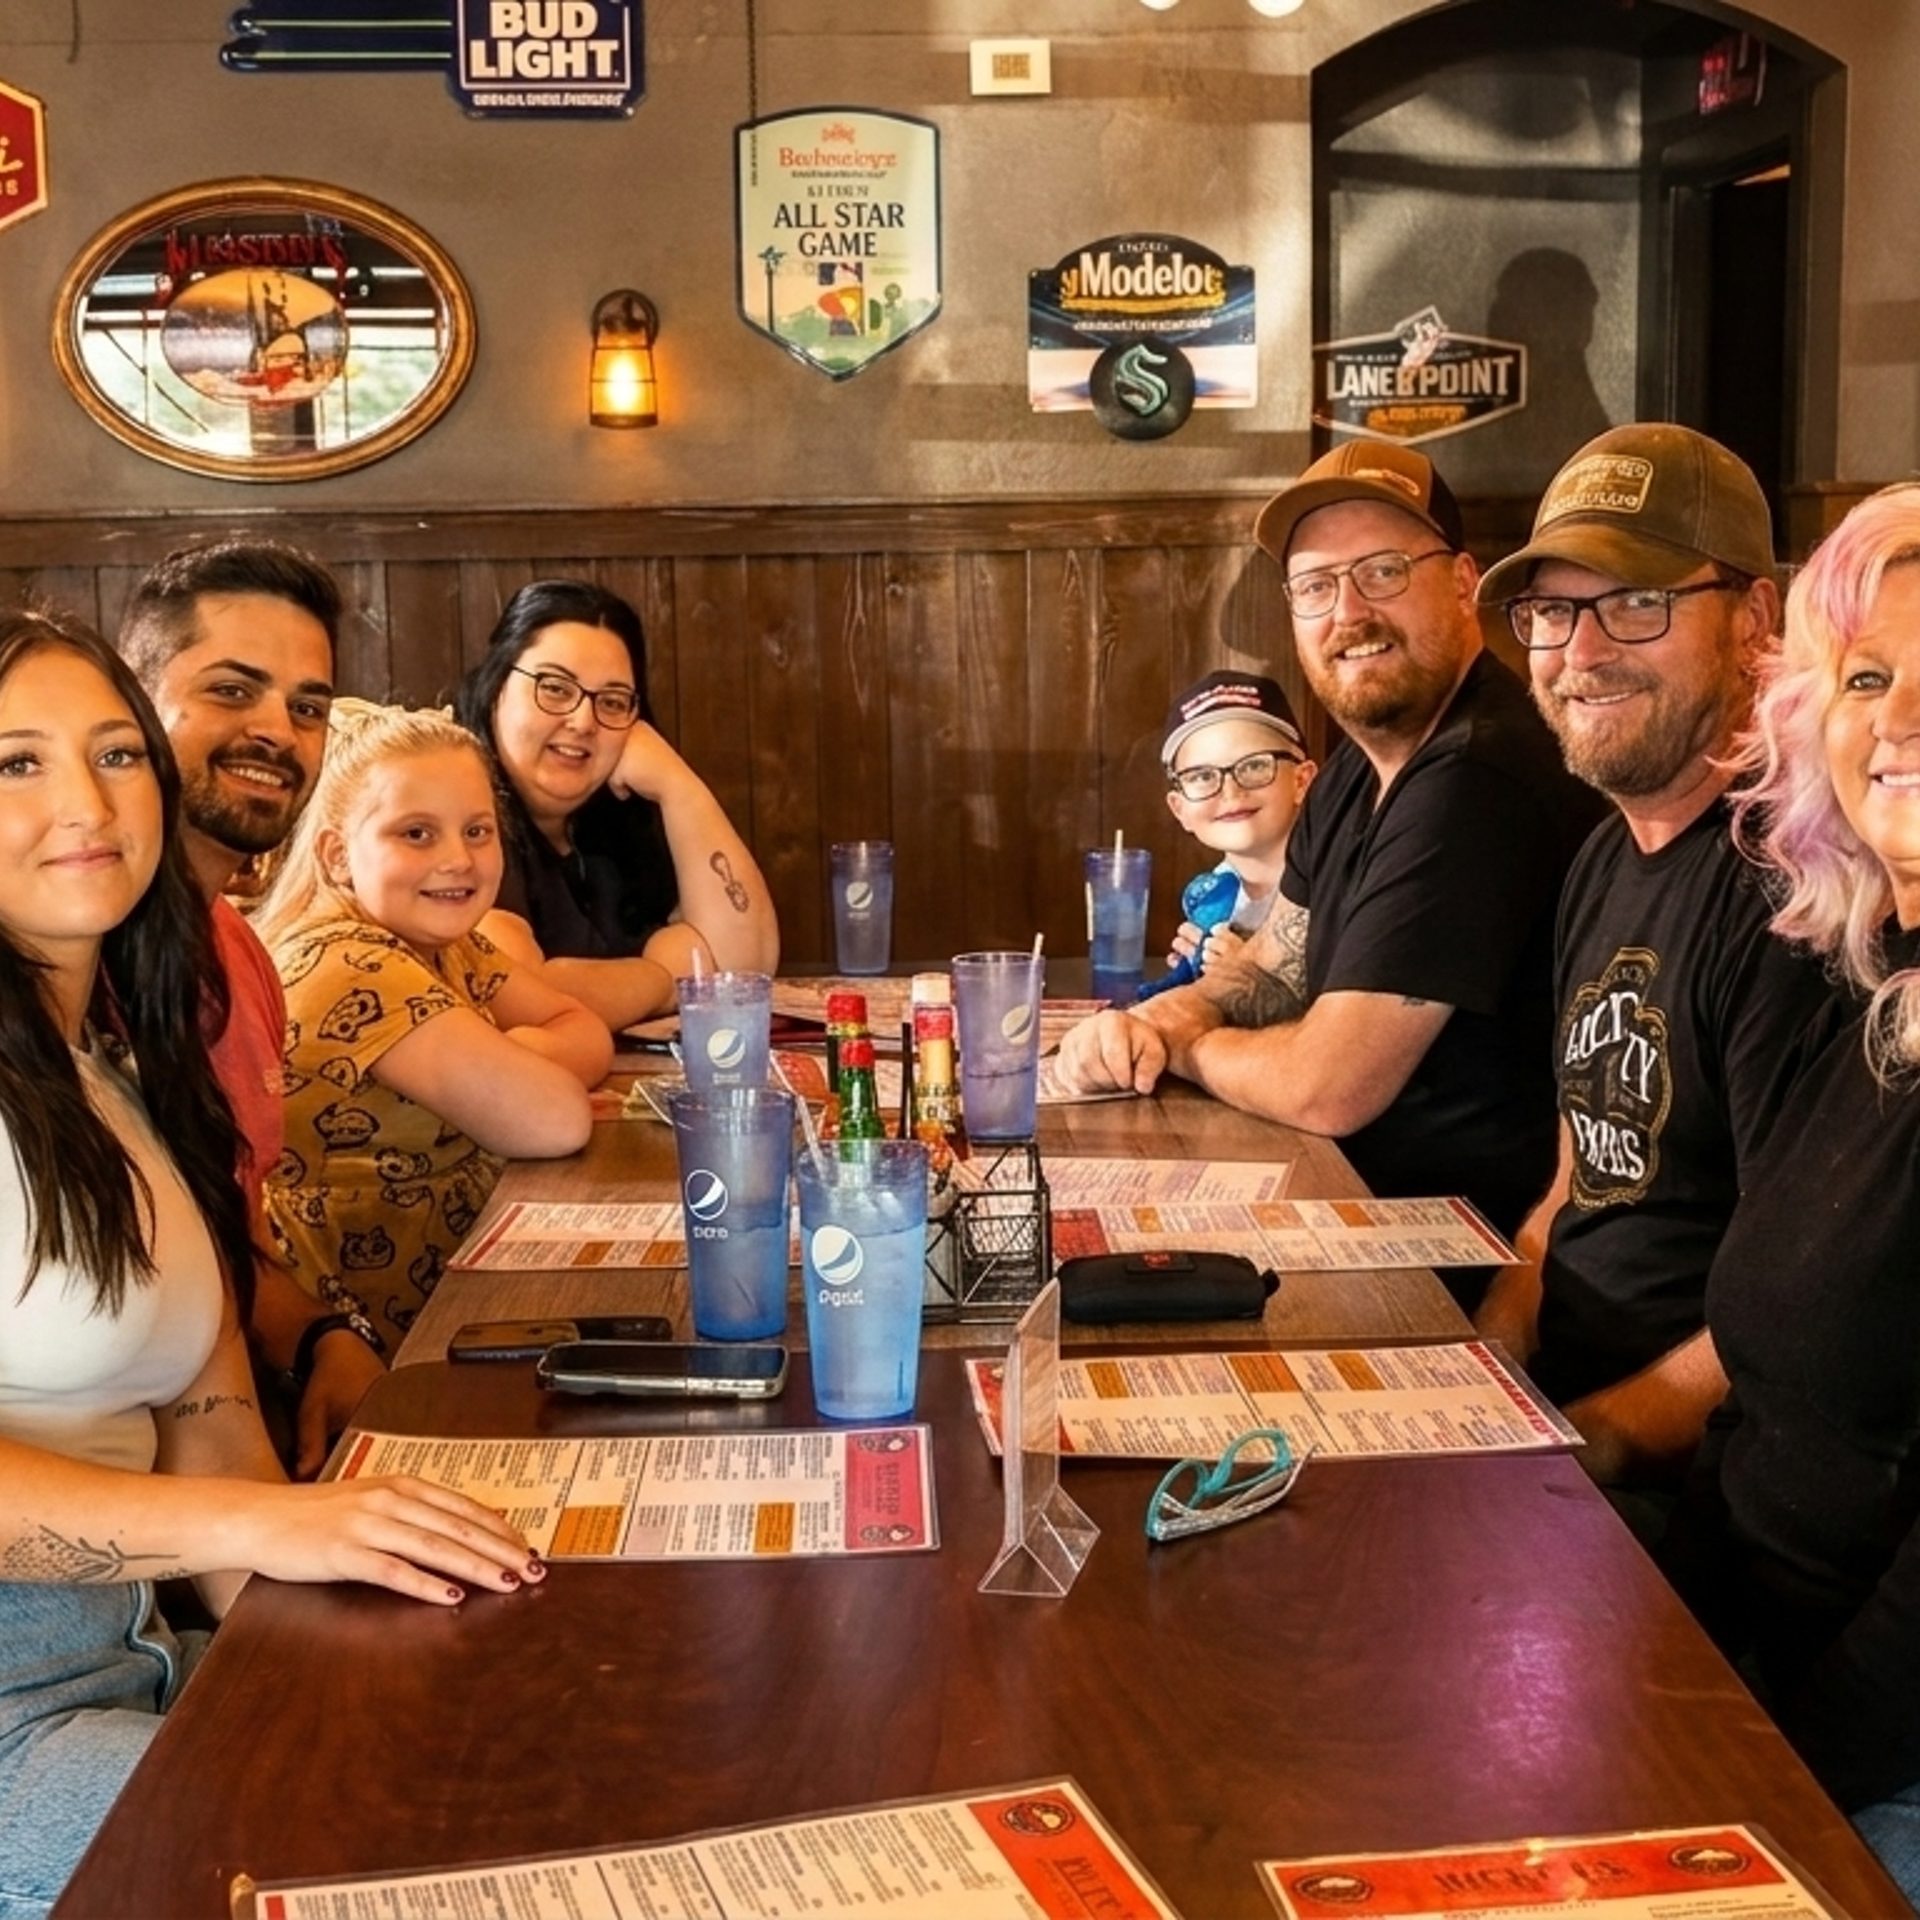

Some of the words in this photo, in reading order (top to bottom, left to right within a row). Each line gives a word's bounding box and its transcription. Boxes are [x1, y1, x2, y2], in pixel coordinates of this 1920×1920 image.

[490, 0, 598, 38] BUD
[470, 40, 619, 78] LIGHT
[773, 203, 828, 229] ALL
[834, 202, 905, 229] STAR
[798, 231, 878, 258] GAME
